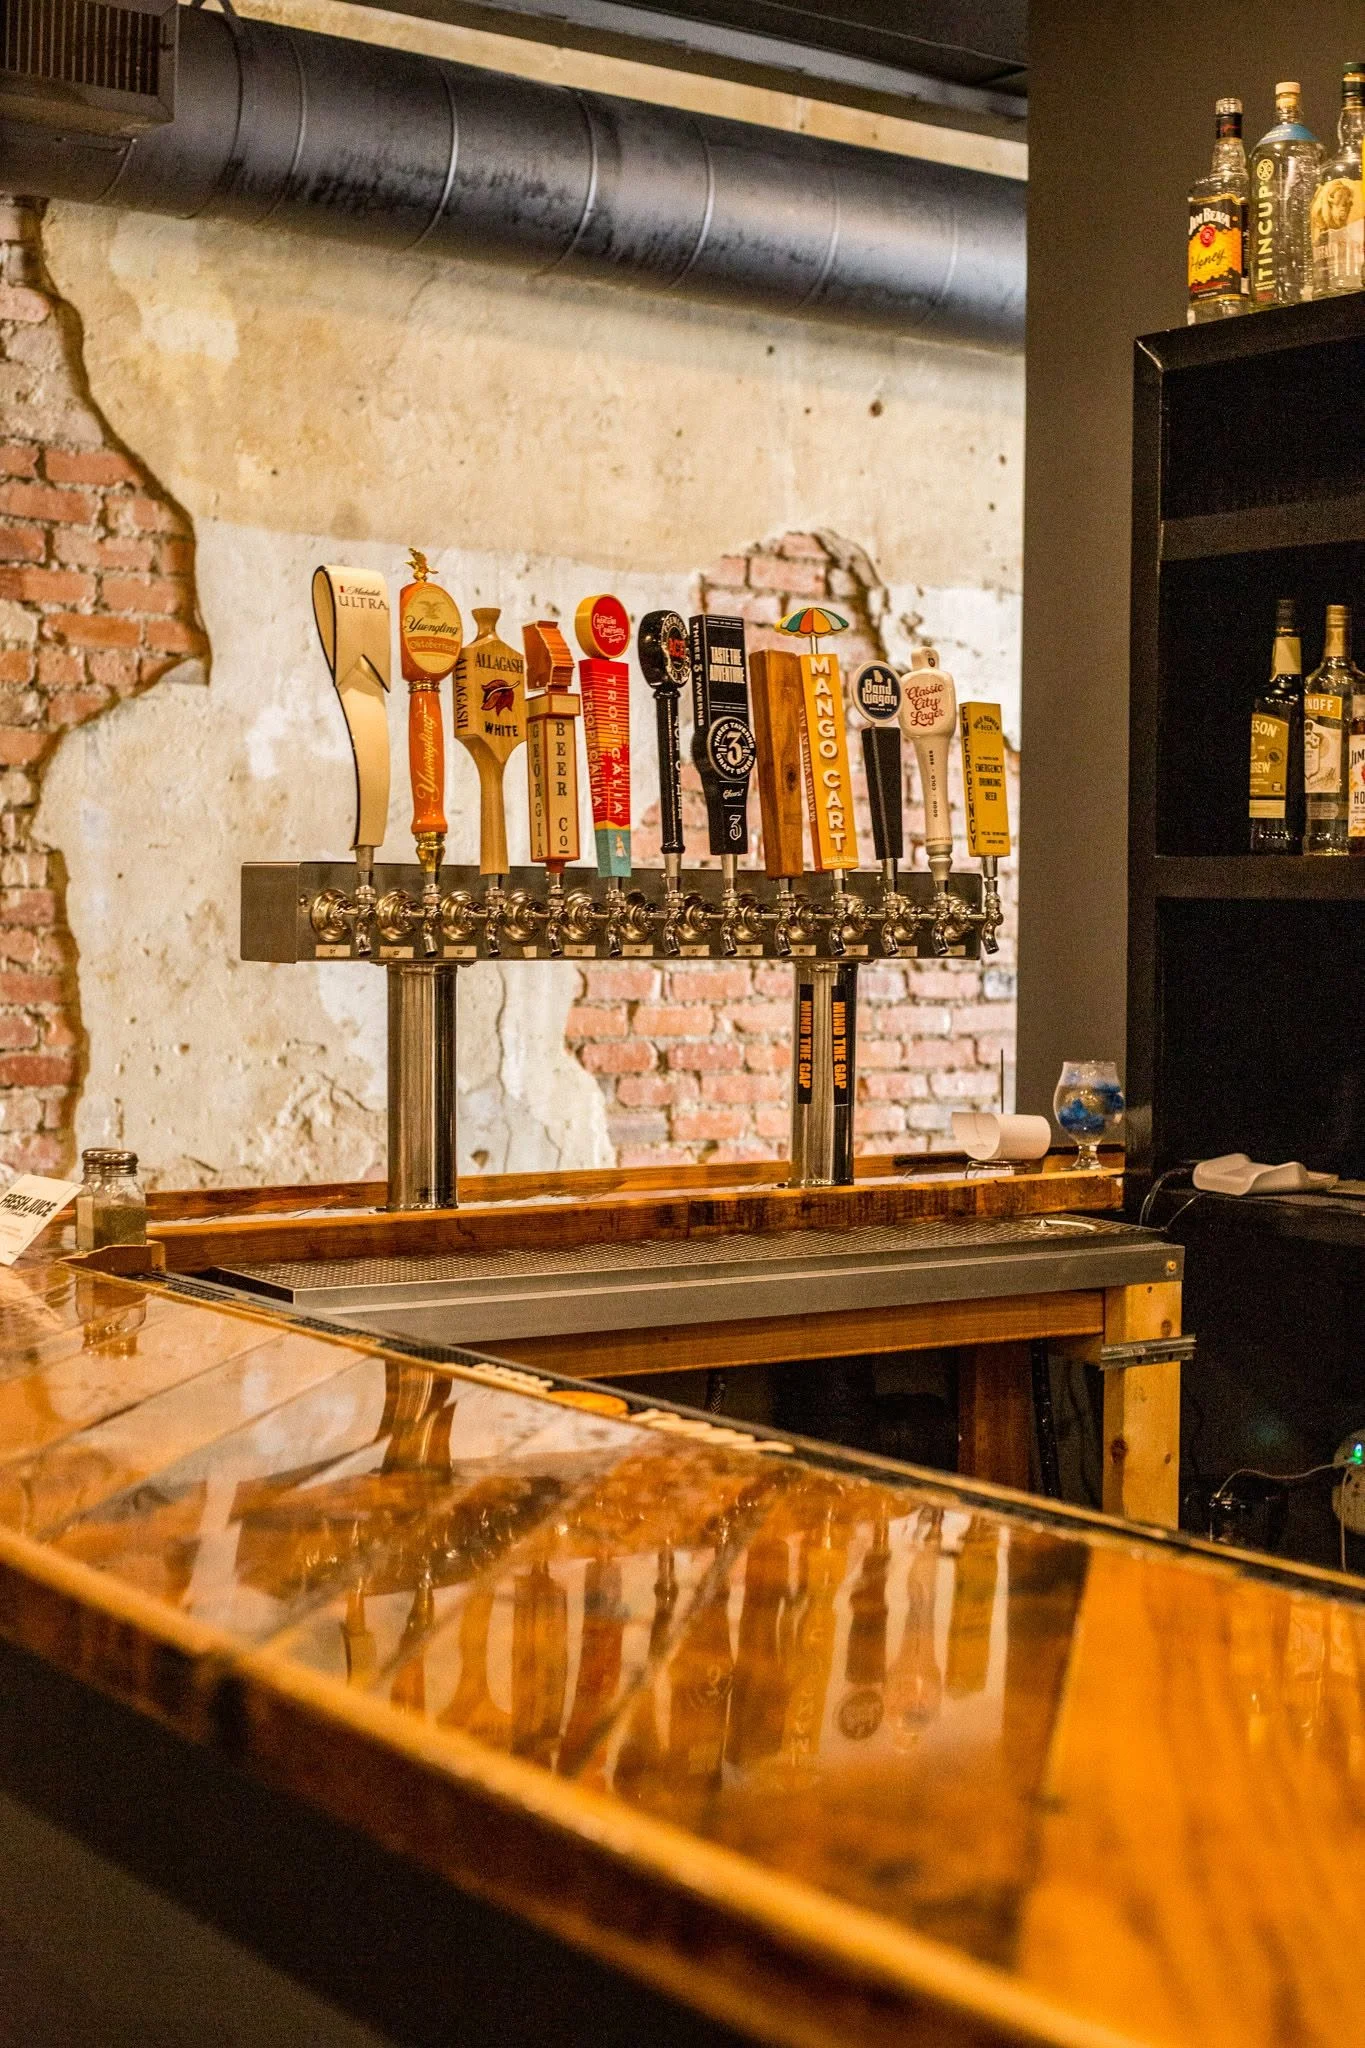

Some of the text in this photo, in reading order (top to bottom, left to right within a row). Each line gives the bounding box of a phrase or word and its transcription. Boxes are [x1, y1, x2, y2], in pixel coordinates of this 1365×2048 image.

[1188, 213, 1203, 235] JIM
[1258, 186, 1273, 281] TINCUP
[338, 595, 389, 611] ULTRA
[404, 615, 458, 637] Yuengling
[475, 651, 524, 674] ALLAGASH
[692, 622, 701, 661] THREE
[695, 674, 705, 727] TAVERNS
[809, 657, 839, 760] MANGO
[905, 683, 944, 700] Classic
[911, 697, 941, 711] City
[484, 720, 519, 737] WHITE
[714, 722, 755, 749] THREE TAVERNS
[910, 709, 945, 727] Lager
[416, 699, 440, 802] Yuengling
[555, 721, 568, 797] BEER
[583, 690, 603, 807] TROPICALIA
[607, 675, 625, 814] TROPICALIA
[715, 753, 755, 775] DRAFT BEERS
[531, 723, 544, 857] GEORGIA
[961, 706, 977, 850] EMERGENCY
[822, 768, 846, 851] CART
[798, 1000, 812, 1089] MIND THE GAP
[832, 1001, 847, 1089] MIND THE GAP
[0, 1193, 33, 1211] FRESH
[23, 1199, 58, 1217] JUICE
